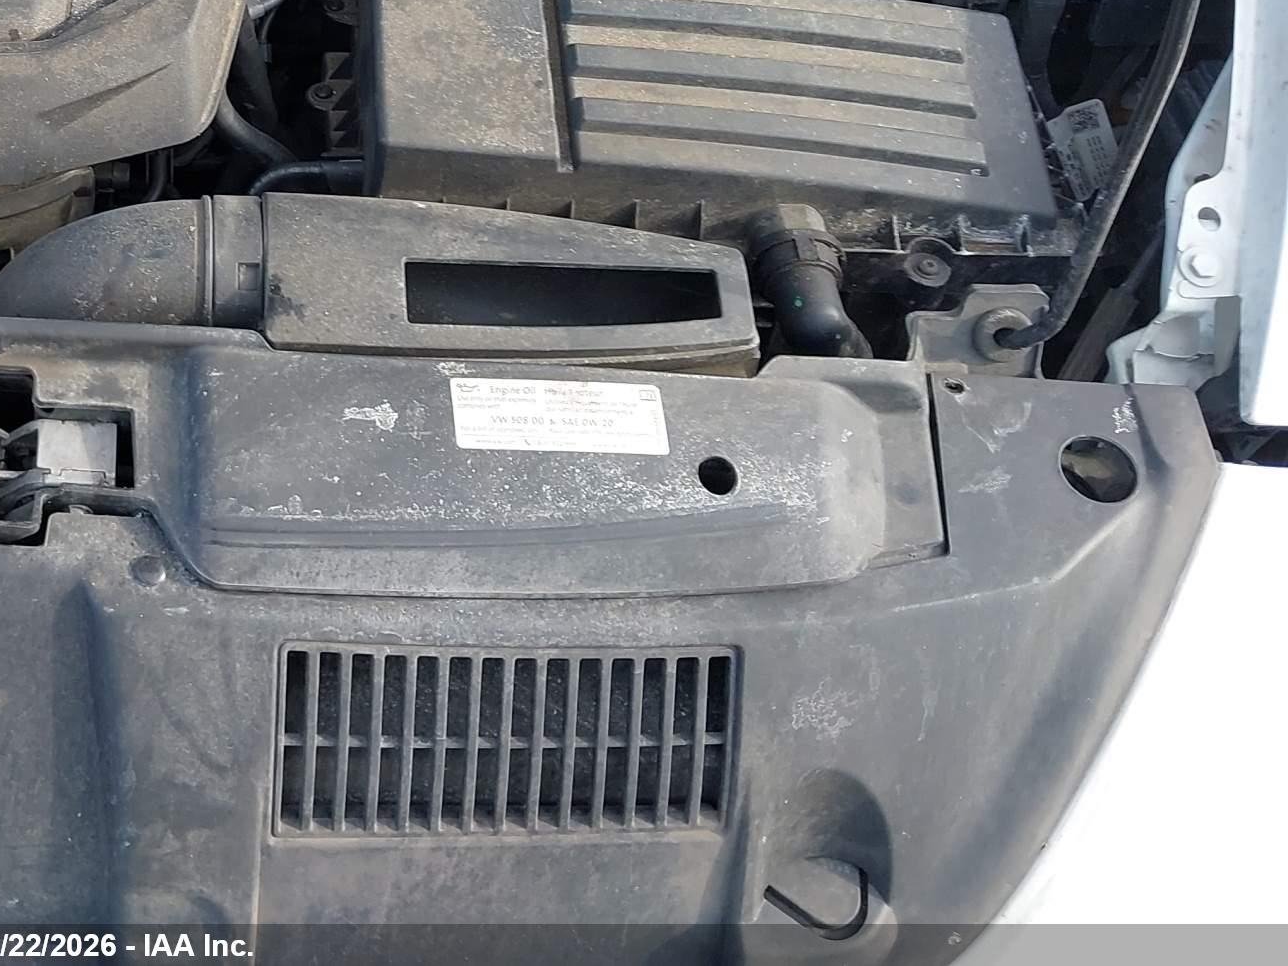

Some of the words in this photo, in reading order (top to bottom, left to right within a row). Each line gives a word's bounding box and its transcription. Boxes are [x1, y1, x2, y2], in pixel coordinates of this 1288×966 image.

[489, 385, 520, 395] Engine
[522, 386, 536, 394] Oil
[490, 415, 507, 423] VW
[531, 416, 544, 424] 00
[560, 417, 579, 426] SAE
